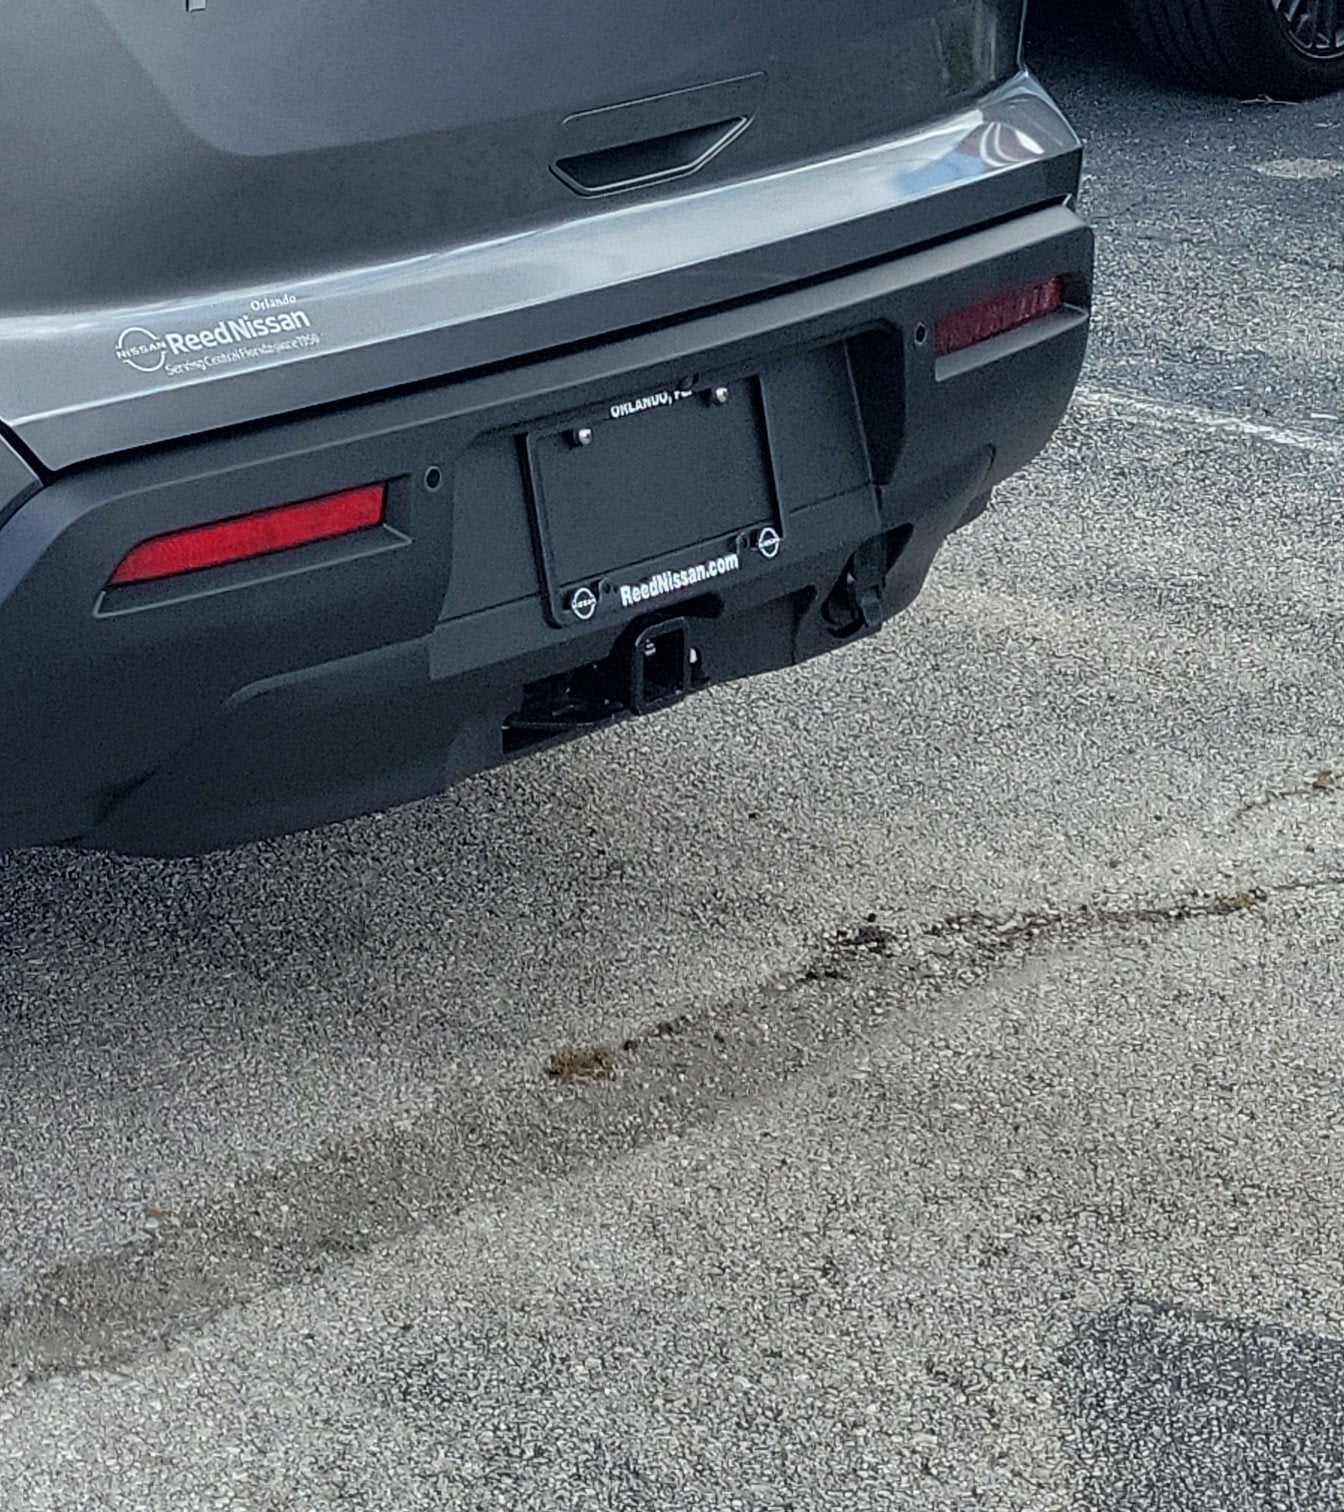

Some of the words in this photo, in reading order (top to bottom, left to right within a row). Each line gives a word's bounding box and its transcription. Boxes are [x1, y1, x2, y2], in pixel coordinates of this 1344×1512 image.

[250, 294, 297, 312] Orlando
[115, 341, 167, 359] NISSAN
[204, 349, 240, 367] Central
[620, 553, 739, 607] ReedNissan.com
